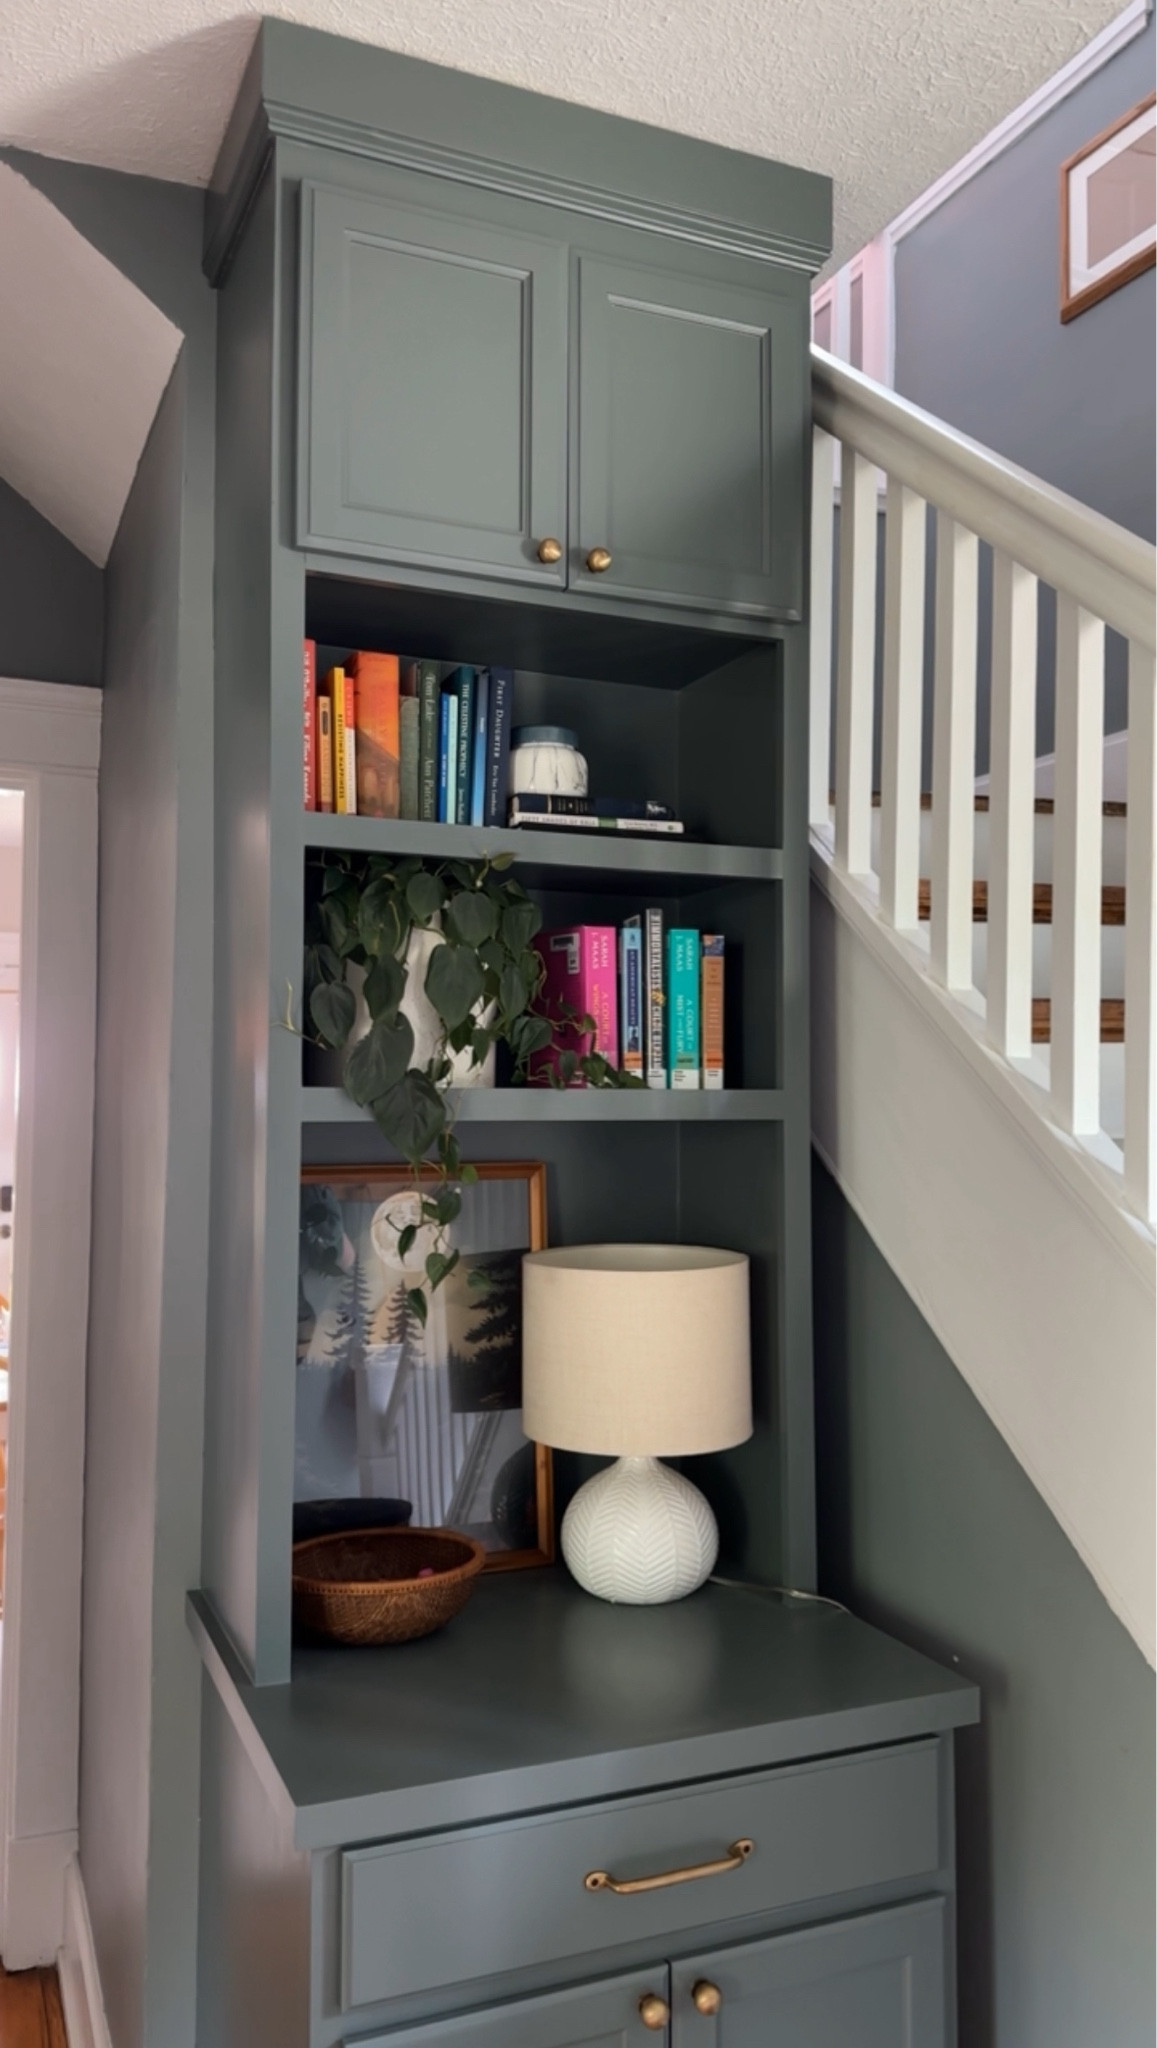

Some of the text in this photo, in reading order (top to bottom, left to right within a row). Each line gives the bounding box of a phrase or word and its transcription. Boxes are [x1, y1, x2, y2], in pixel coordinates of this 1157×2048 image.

[425, 673, 436, 695] Tom
[425, 699, 435, 722] Lake
[493, 680, 505, 758] FIRST DAUGHTER
[459, 684, 470, 778] THE CELESTINE PROPHECY
[424, 757, 434, 776] Ann
[424, 780, 434, 818] Patchett
[521, 815, 540, 823] FIFTY
[542, 817, 568, 825] SHADES
[569, 818, 578, 826] OF
[591, 941, 600, 969] MAAS
[600, 935, 609, 967] SARAH
[651, 922, 662, 990] IMMORTALISTS
[676, 944, 684, 972] MAAS
[686, 937, 694, 970] SARAH
[592, 984, 600, 1016] WINGS
[676, 995, 684, 1016] MIST
[601, 1002, 609, 1035] COURT
[686, 1009, 694, 1041] COURT
[676, 1030, 684, 1053] FURY
